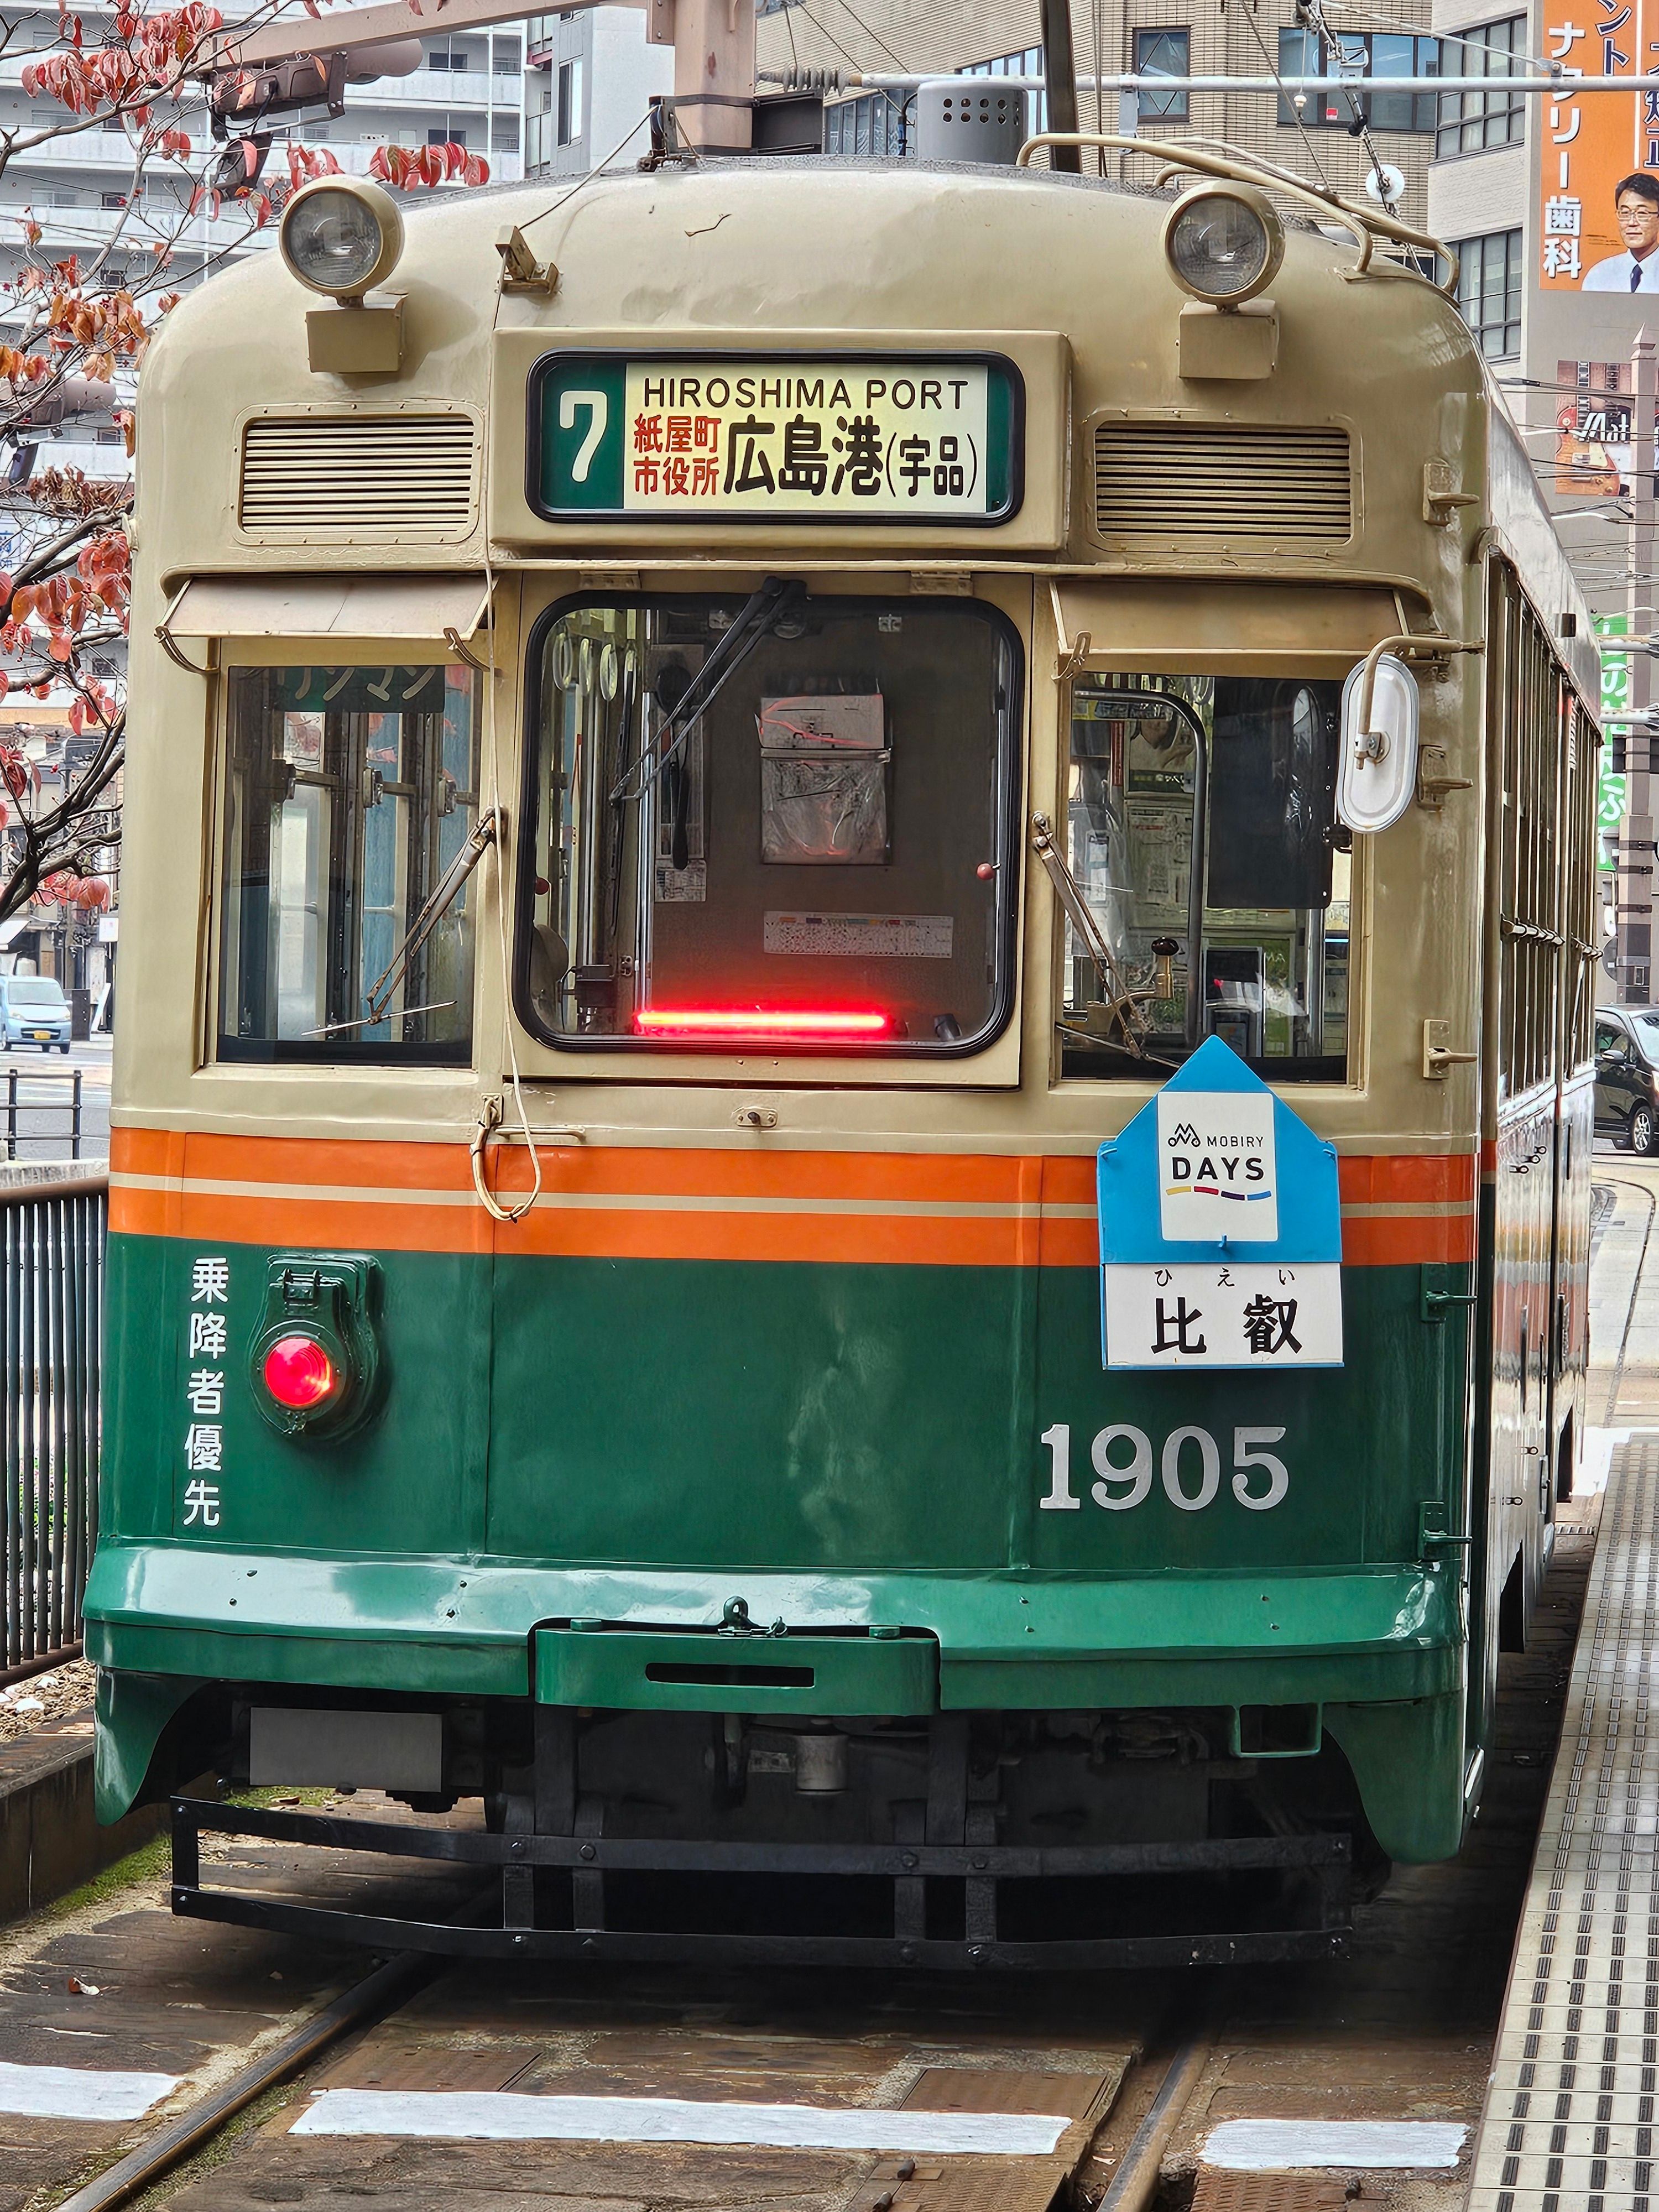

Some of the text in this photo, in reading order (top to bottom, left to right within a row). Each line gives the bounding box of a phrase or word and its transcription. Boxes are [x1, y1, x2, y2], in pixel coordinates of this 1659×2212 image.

[644, 378, 968, 410] HIROSHIMA PORT
[559, 390, 608, 483] 7
[634, 413, 721, 453] 紙屋町
[634, 456, 719, 496] 市役所
[1207, 1135, 1264, 1147] MOBIRY
[1172, 1157, 1264, 1181] DAYS
[1151, 1293, 1303, 1355] 比叡
[182, 1256, 230, 1527] 乗降者優先
[1039, 1423, 1289, 1511] 1905
